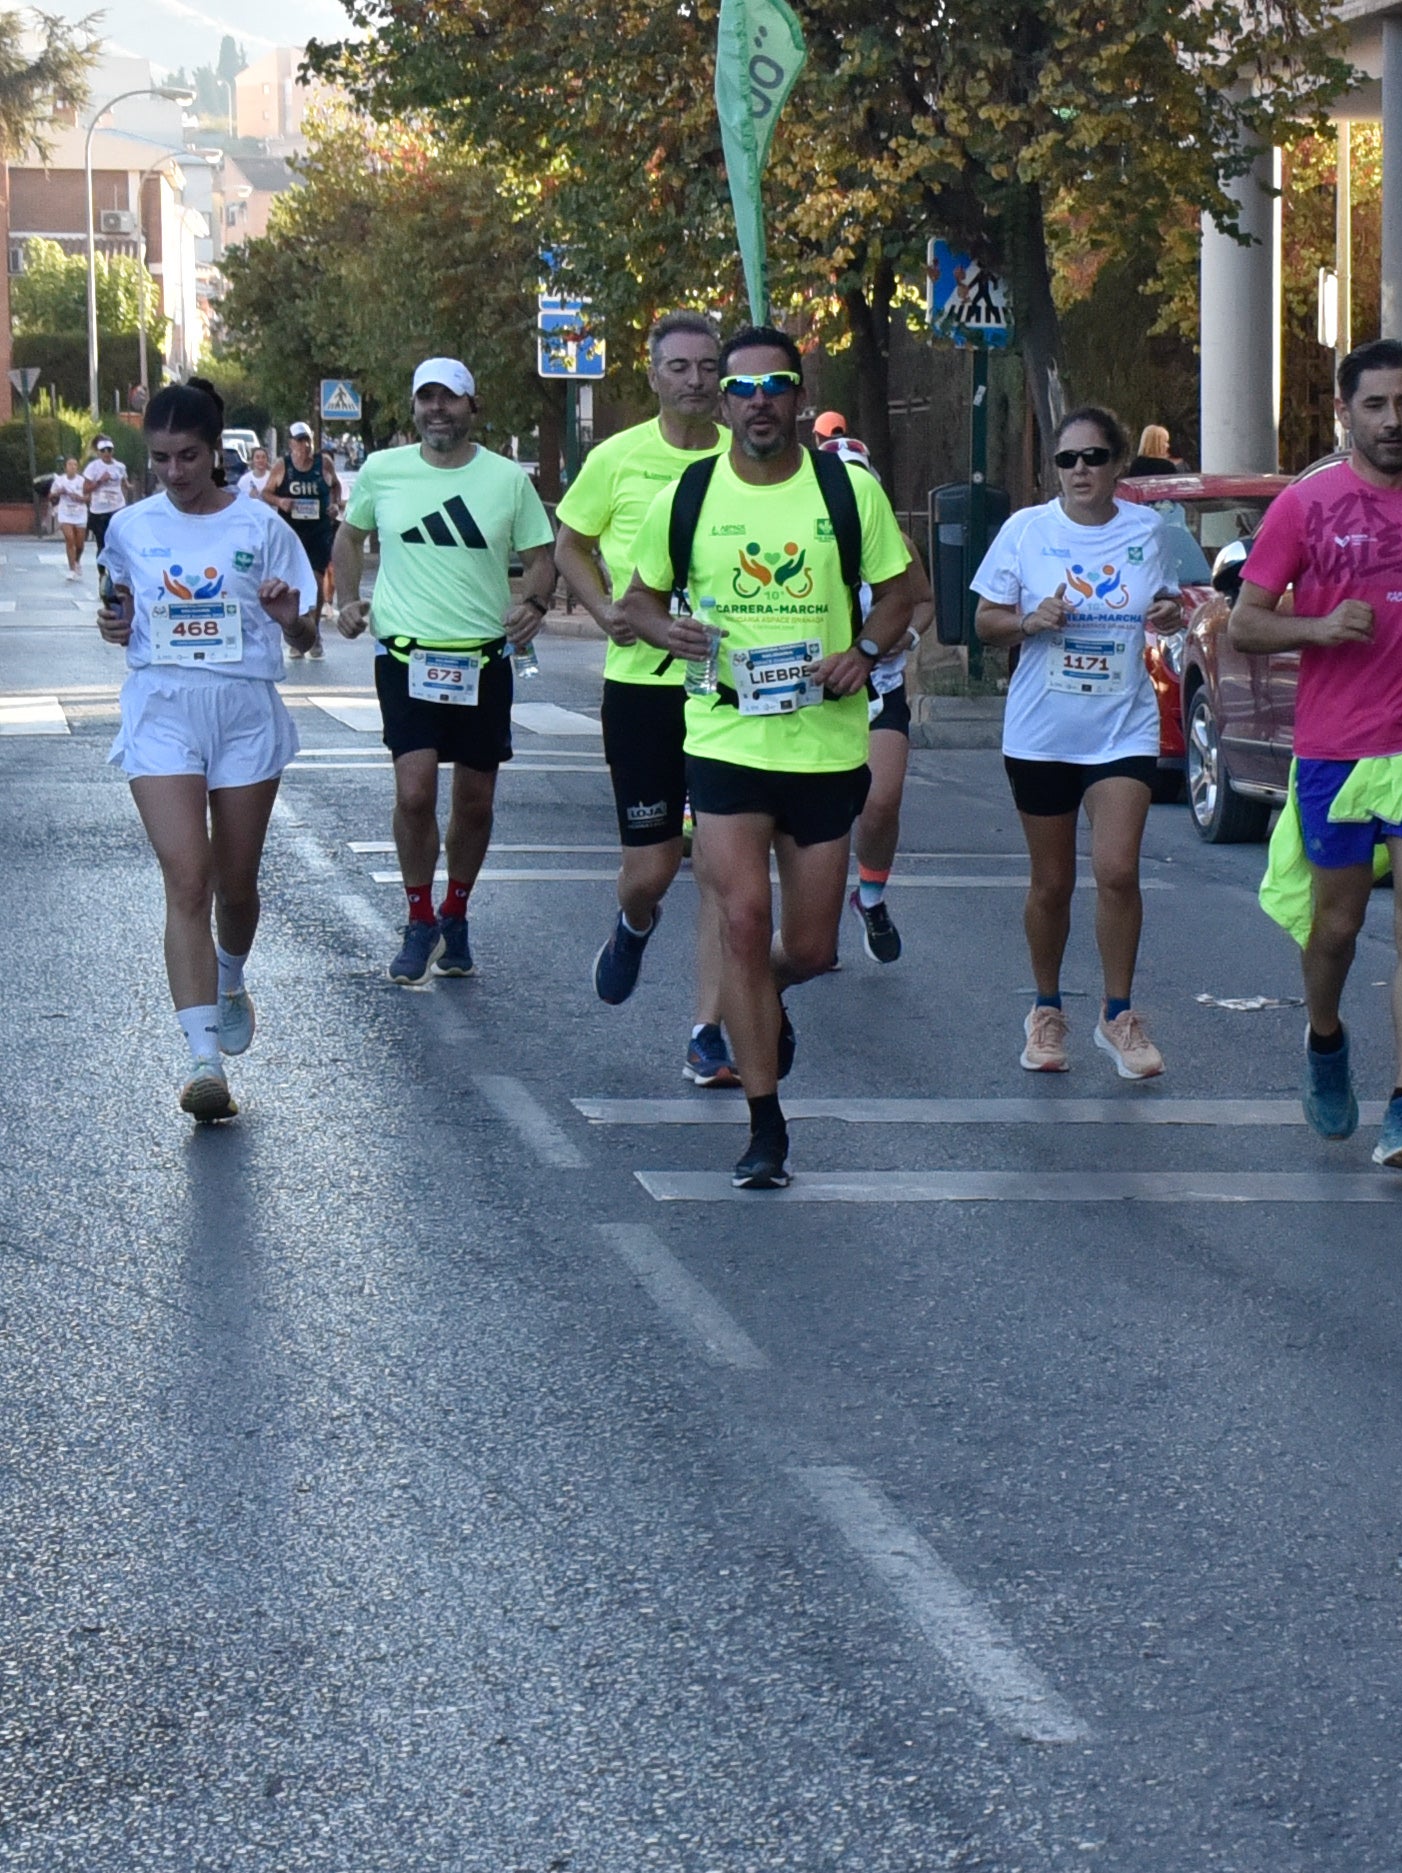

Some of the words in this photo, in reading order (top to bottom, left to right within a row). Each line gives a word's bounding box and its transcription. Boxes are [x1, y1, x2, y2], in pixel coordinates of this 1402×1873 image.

[715, 603, 830, 615] CARRERA-MARCHA
[172, 620, 219, 637] 468
[1063, 654, 1110, 672] 1171
[427, 668, 463, 683] 673
[749, 665, 811, 685] LIEBRE
[630, 807, 664, 818] LOJA
